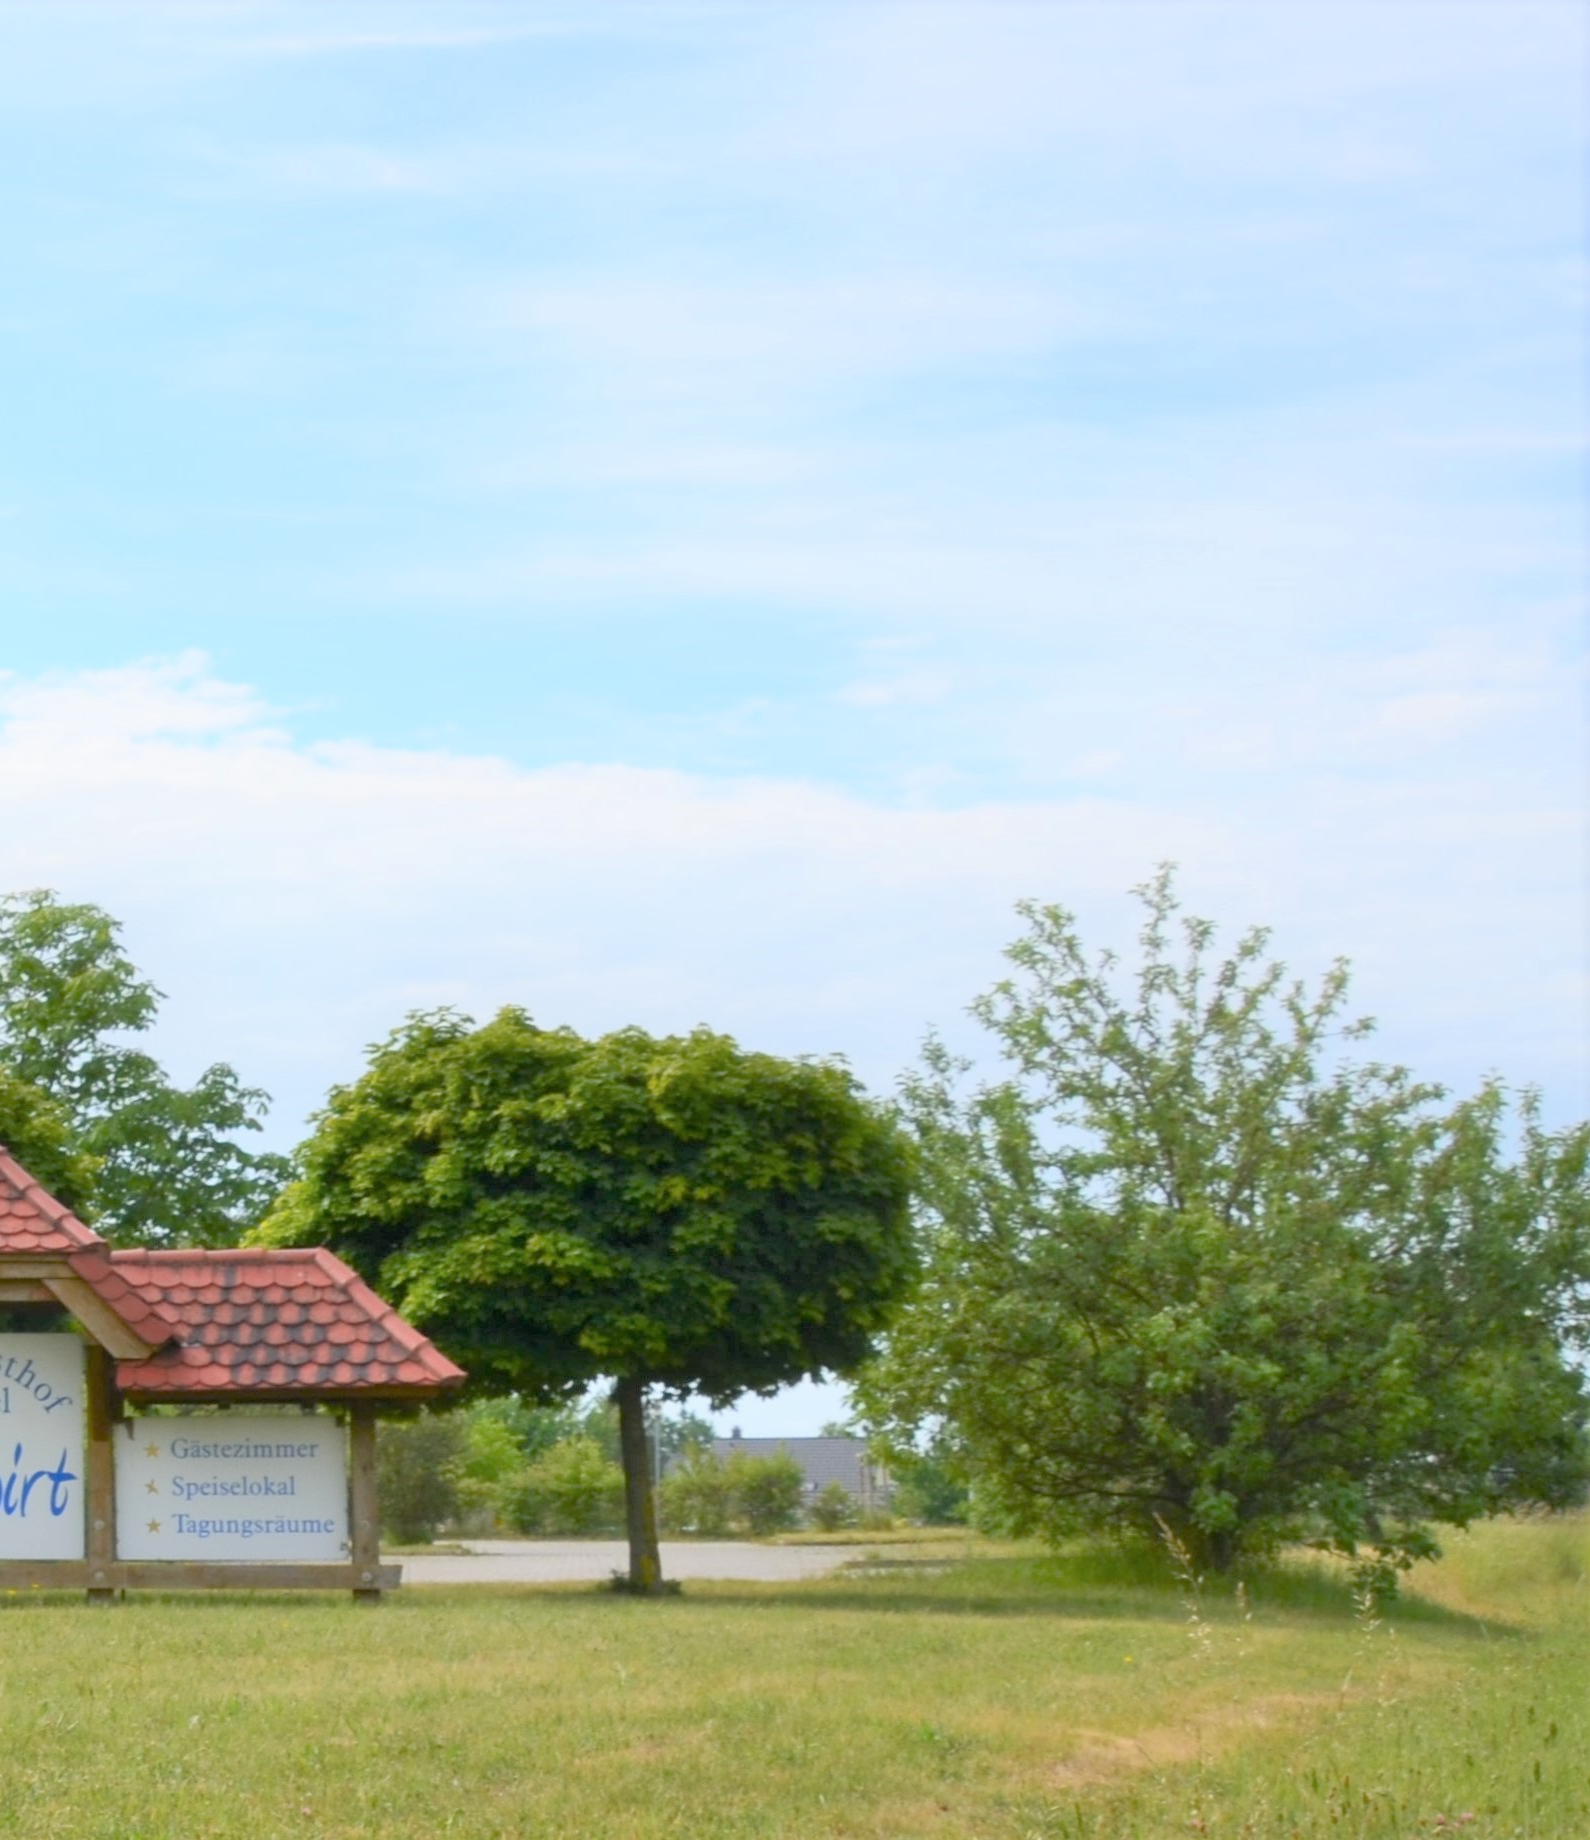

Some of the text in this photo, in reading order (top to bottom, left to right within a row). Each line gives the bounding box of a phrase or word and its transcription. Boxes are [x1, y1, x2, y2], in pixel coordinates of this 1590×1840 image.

[170, 1437, 319, 1459] Gästezimmer
[171, 1475, 297, 1501] Speiselokal
[171, 1512, 336, 1539] Tagungsräume
